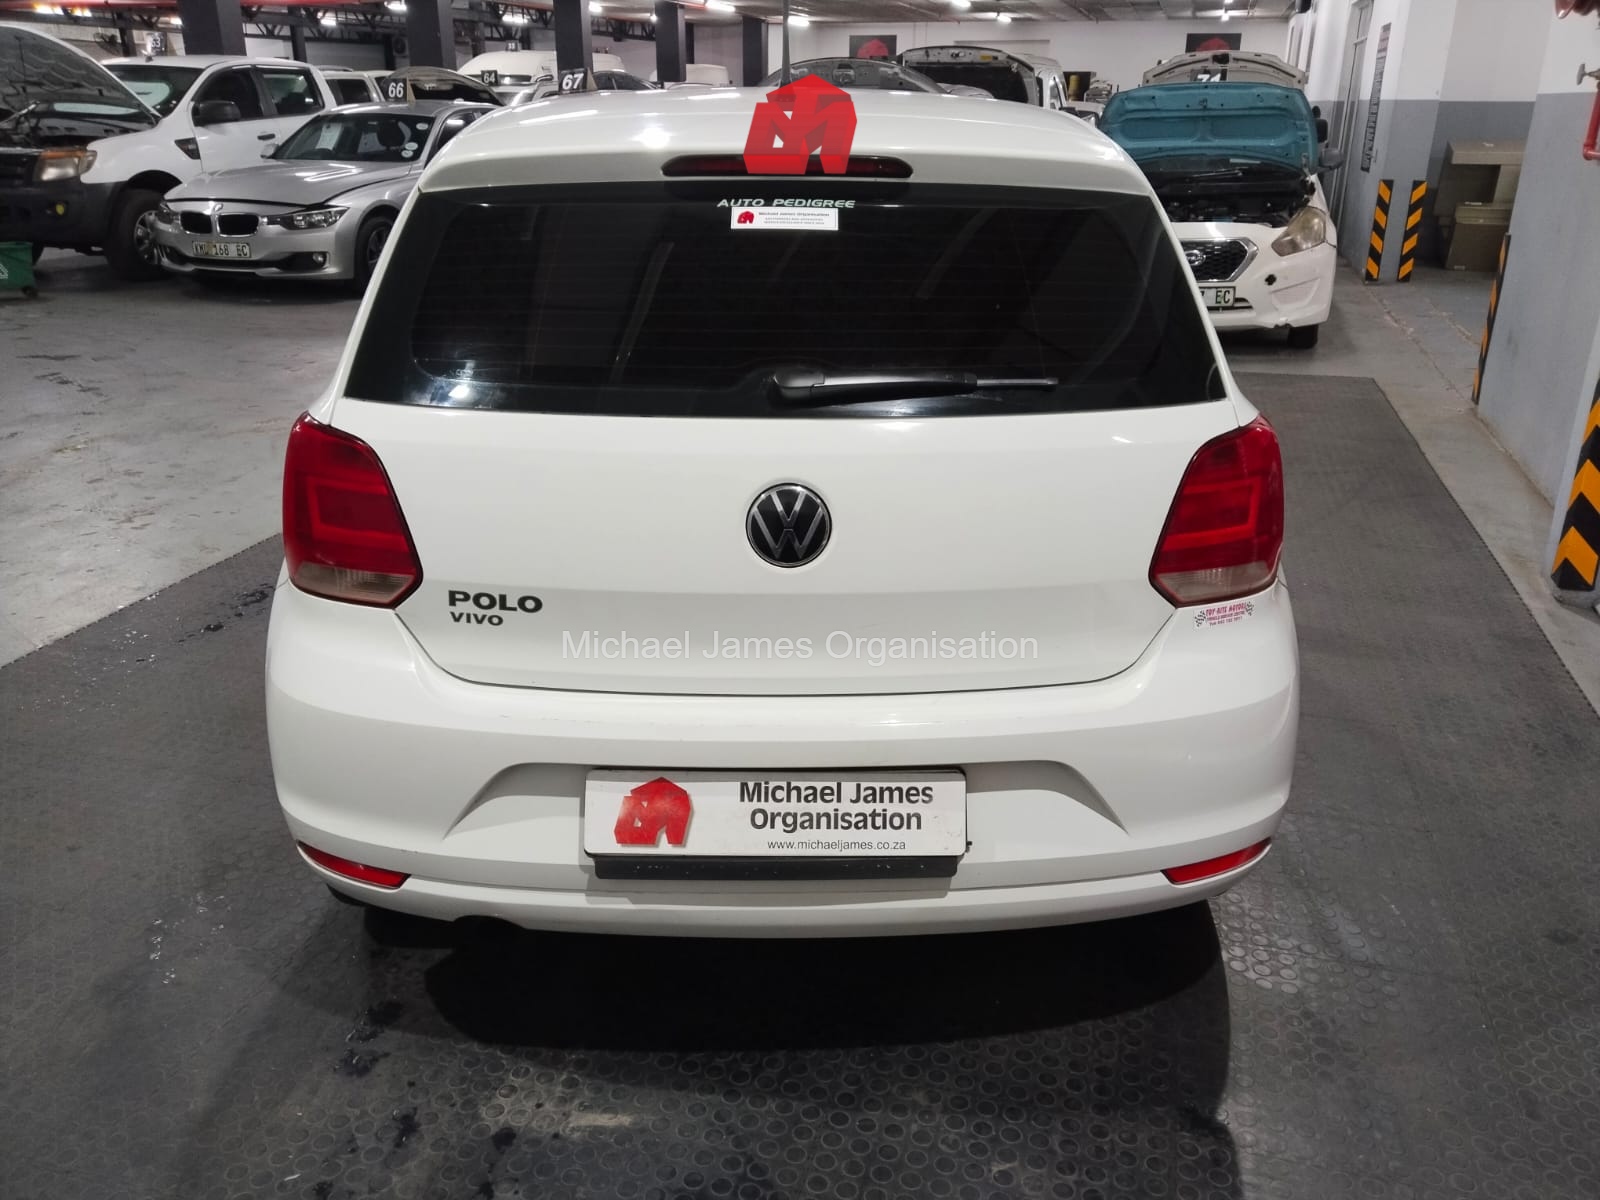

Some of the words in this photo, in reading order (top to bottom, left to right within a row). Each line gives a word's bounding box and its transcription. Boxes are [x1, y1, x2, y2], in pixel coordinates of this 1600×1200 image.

[483, 72, 496, 84] 64
[562, 74, 584, 90] 67
[388, 82, 404, 98] 66
[716, 198, 765, 207] AUTO
[772, 198, 856, 208] PEDIGREE
[214, 244, 230, 256] 168
[235, 244, 248, 257] EC
[1215, 290, 1231, 304] EC
[448, 590, 543, 613] POLO
[450, 611, 504, 626] VIVO
[739, 781, 842, 804] Michael
[850, 782, 934, 804] James
[750, 808, 923, 834] Organisation
[767, 840, 906, 852] www.michaeljames.co.za
